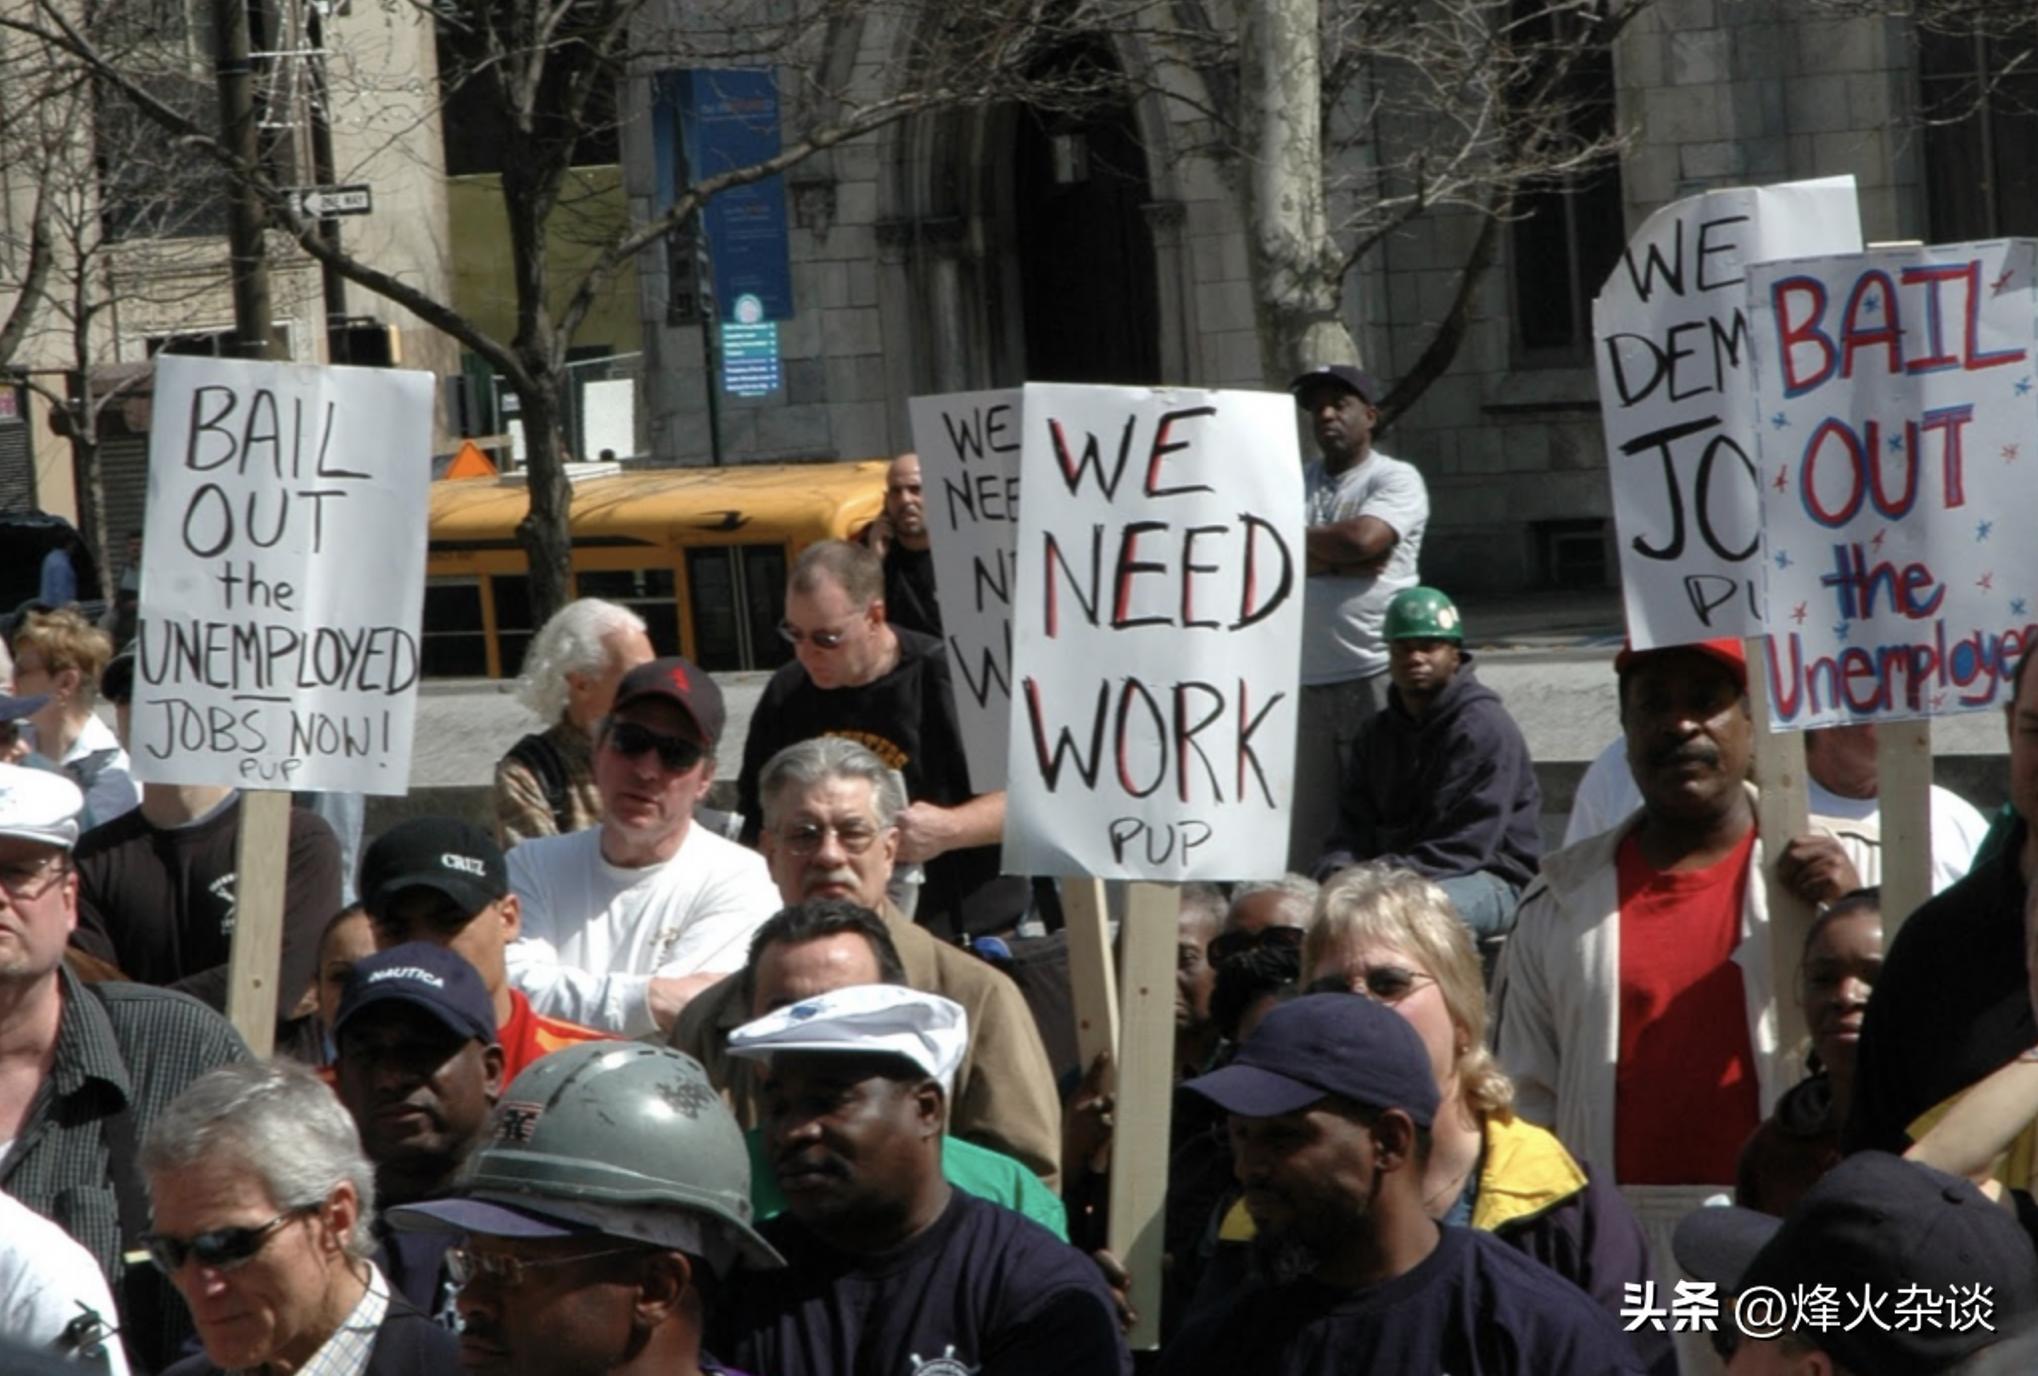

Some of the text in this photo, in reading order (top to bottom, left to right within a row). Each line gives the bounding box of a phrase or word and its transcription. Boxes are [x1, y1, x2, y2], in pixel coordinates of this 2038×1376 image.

[1625, 216, 1749, 302] WE
[1603, 307, 1749, 407] DEM
[1771, 260, 2027, 398] BAIL
[185, 386, 372, 479] BAIL
[941, 405, 1020, 463] WE
[1047, 406, 1217, 503] WE
[1801, 404, 1974, 528] OUT
[182, 483, 347, 558] OUT
[1618, 415, 1759, 561] JO
[216, 560, 296, 611] the
[1043, 513, 1294, 638] NEED
[1821, 543, 1946, 619] the
[139, 619, 419, 695] UNEMPLOYED
[145, 698, 390, 768] JOBS NOW!
[239, 759, 303, 781] PUP
[1022, 676, 1285, 809] WORK
[441, 853, 486, 877] CRUZ
[1109, 816, 1213, 866] PUP
[368, 966, 445, 988] NAUTICA
